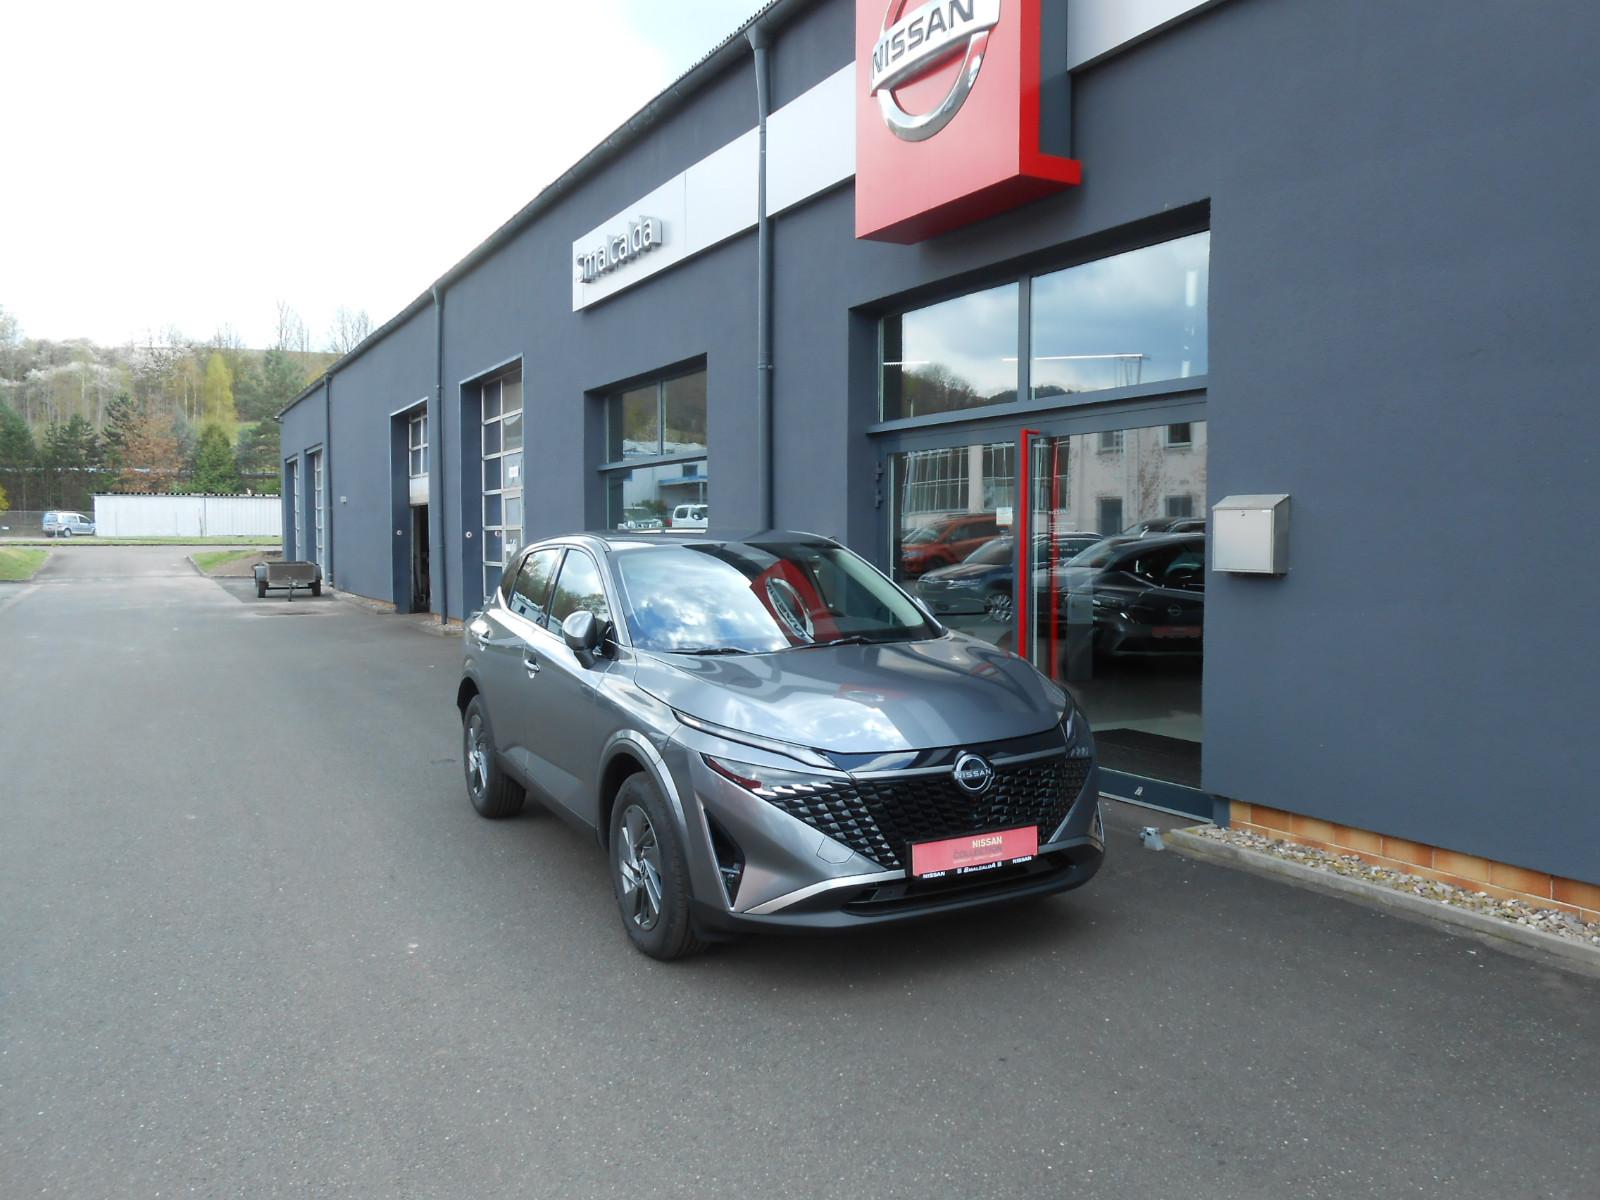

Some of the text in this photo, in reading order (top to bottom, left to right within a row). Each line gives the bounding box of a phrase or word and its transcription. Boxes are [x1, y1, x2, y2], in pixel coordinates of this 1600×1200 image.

[872, 0, 975, 78] NISSAN
[954, 768, 992, 779] NISSAN
[972, 836, 1002, 848] NISSAN
